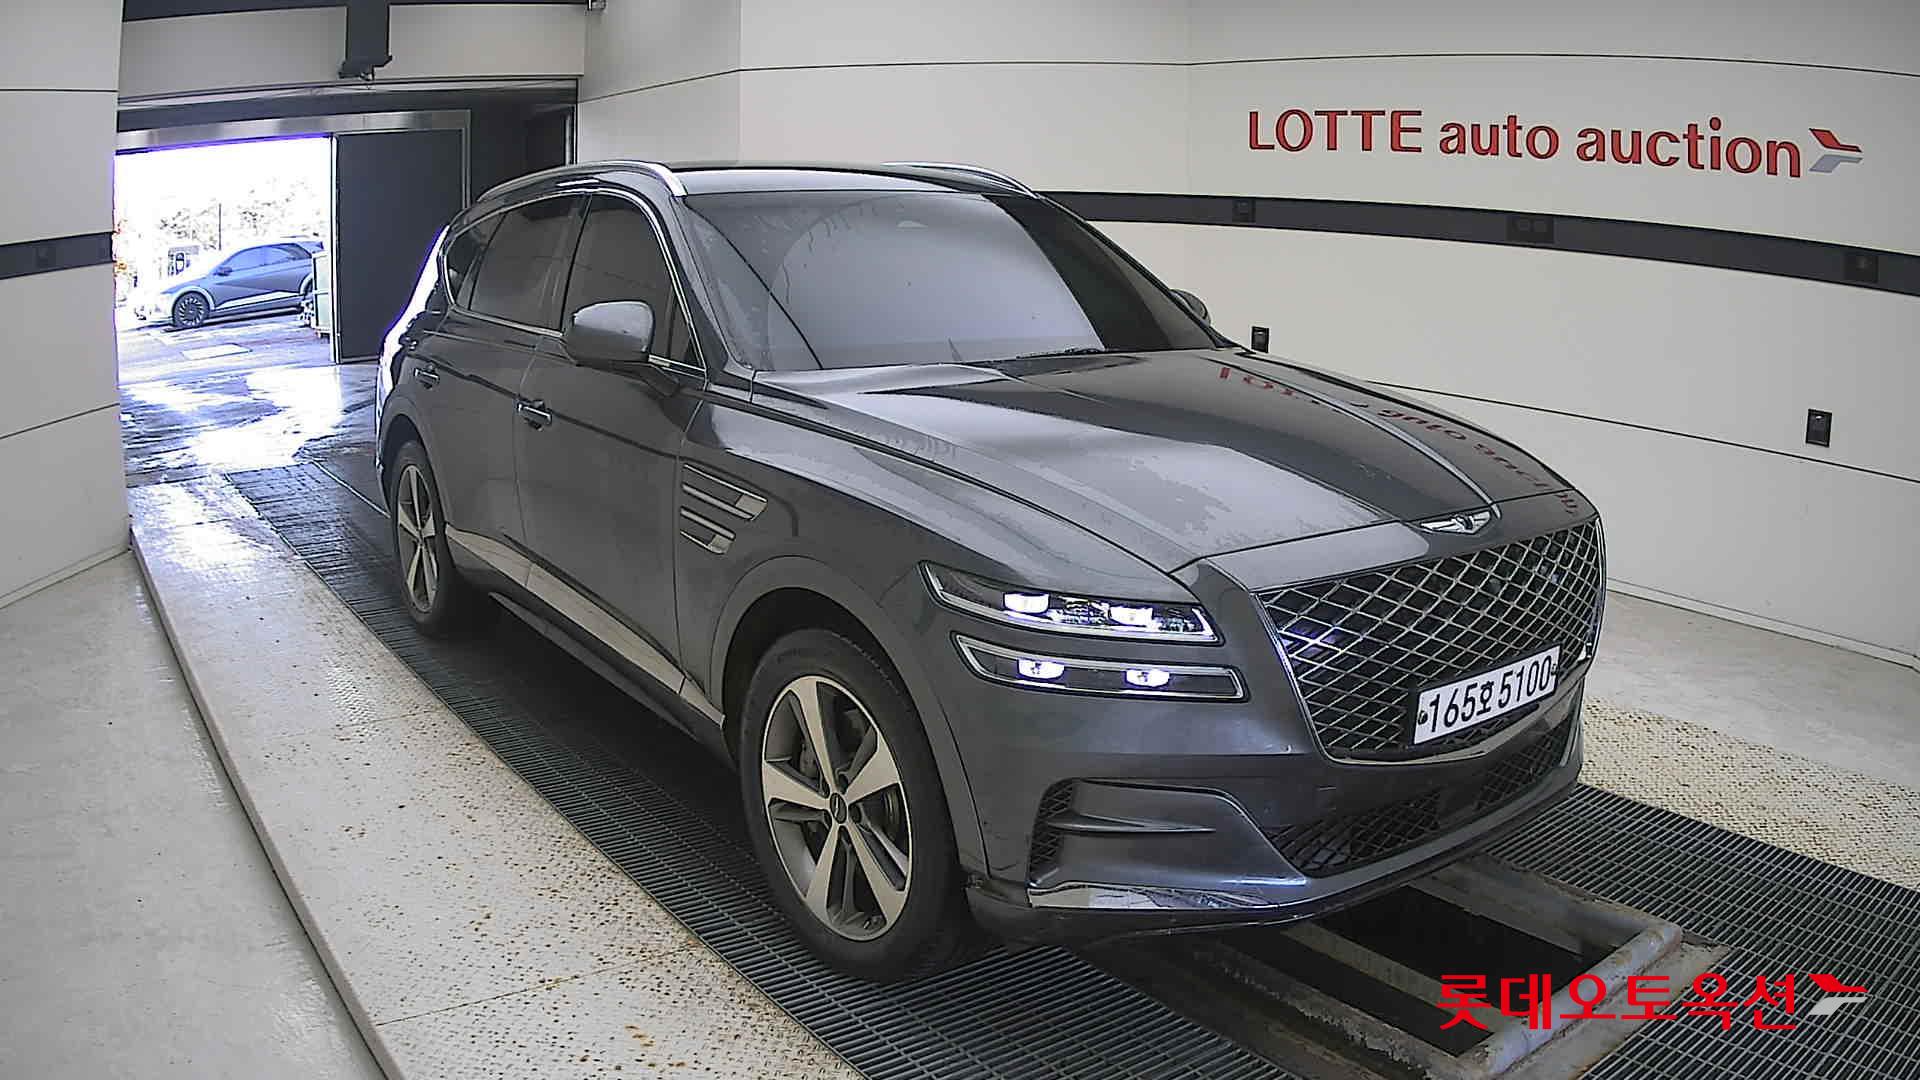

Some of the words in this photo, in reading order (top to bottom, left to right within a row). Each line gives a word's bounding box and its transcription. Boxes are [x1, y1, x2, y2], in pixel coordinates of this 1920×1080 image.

[1248, 109, 1423, 153] LOTTE
[1438, 114, 1561, 159] auto
[1575, 117, 1803, 178] auction
